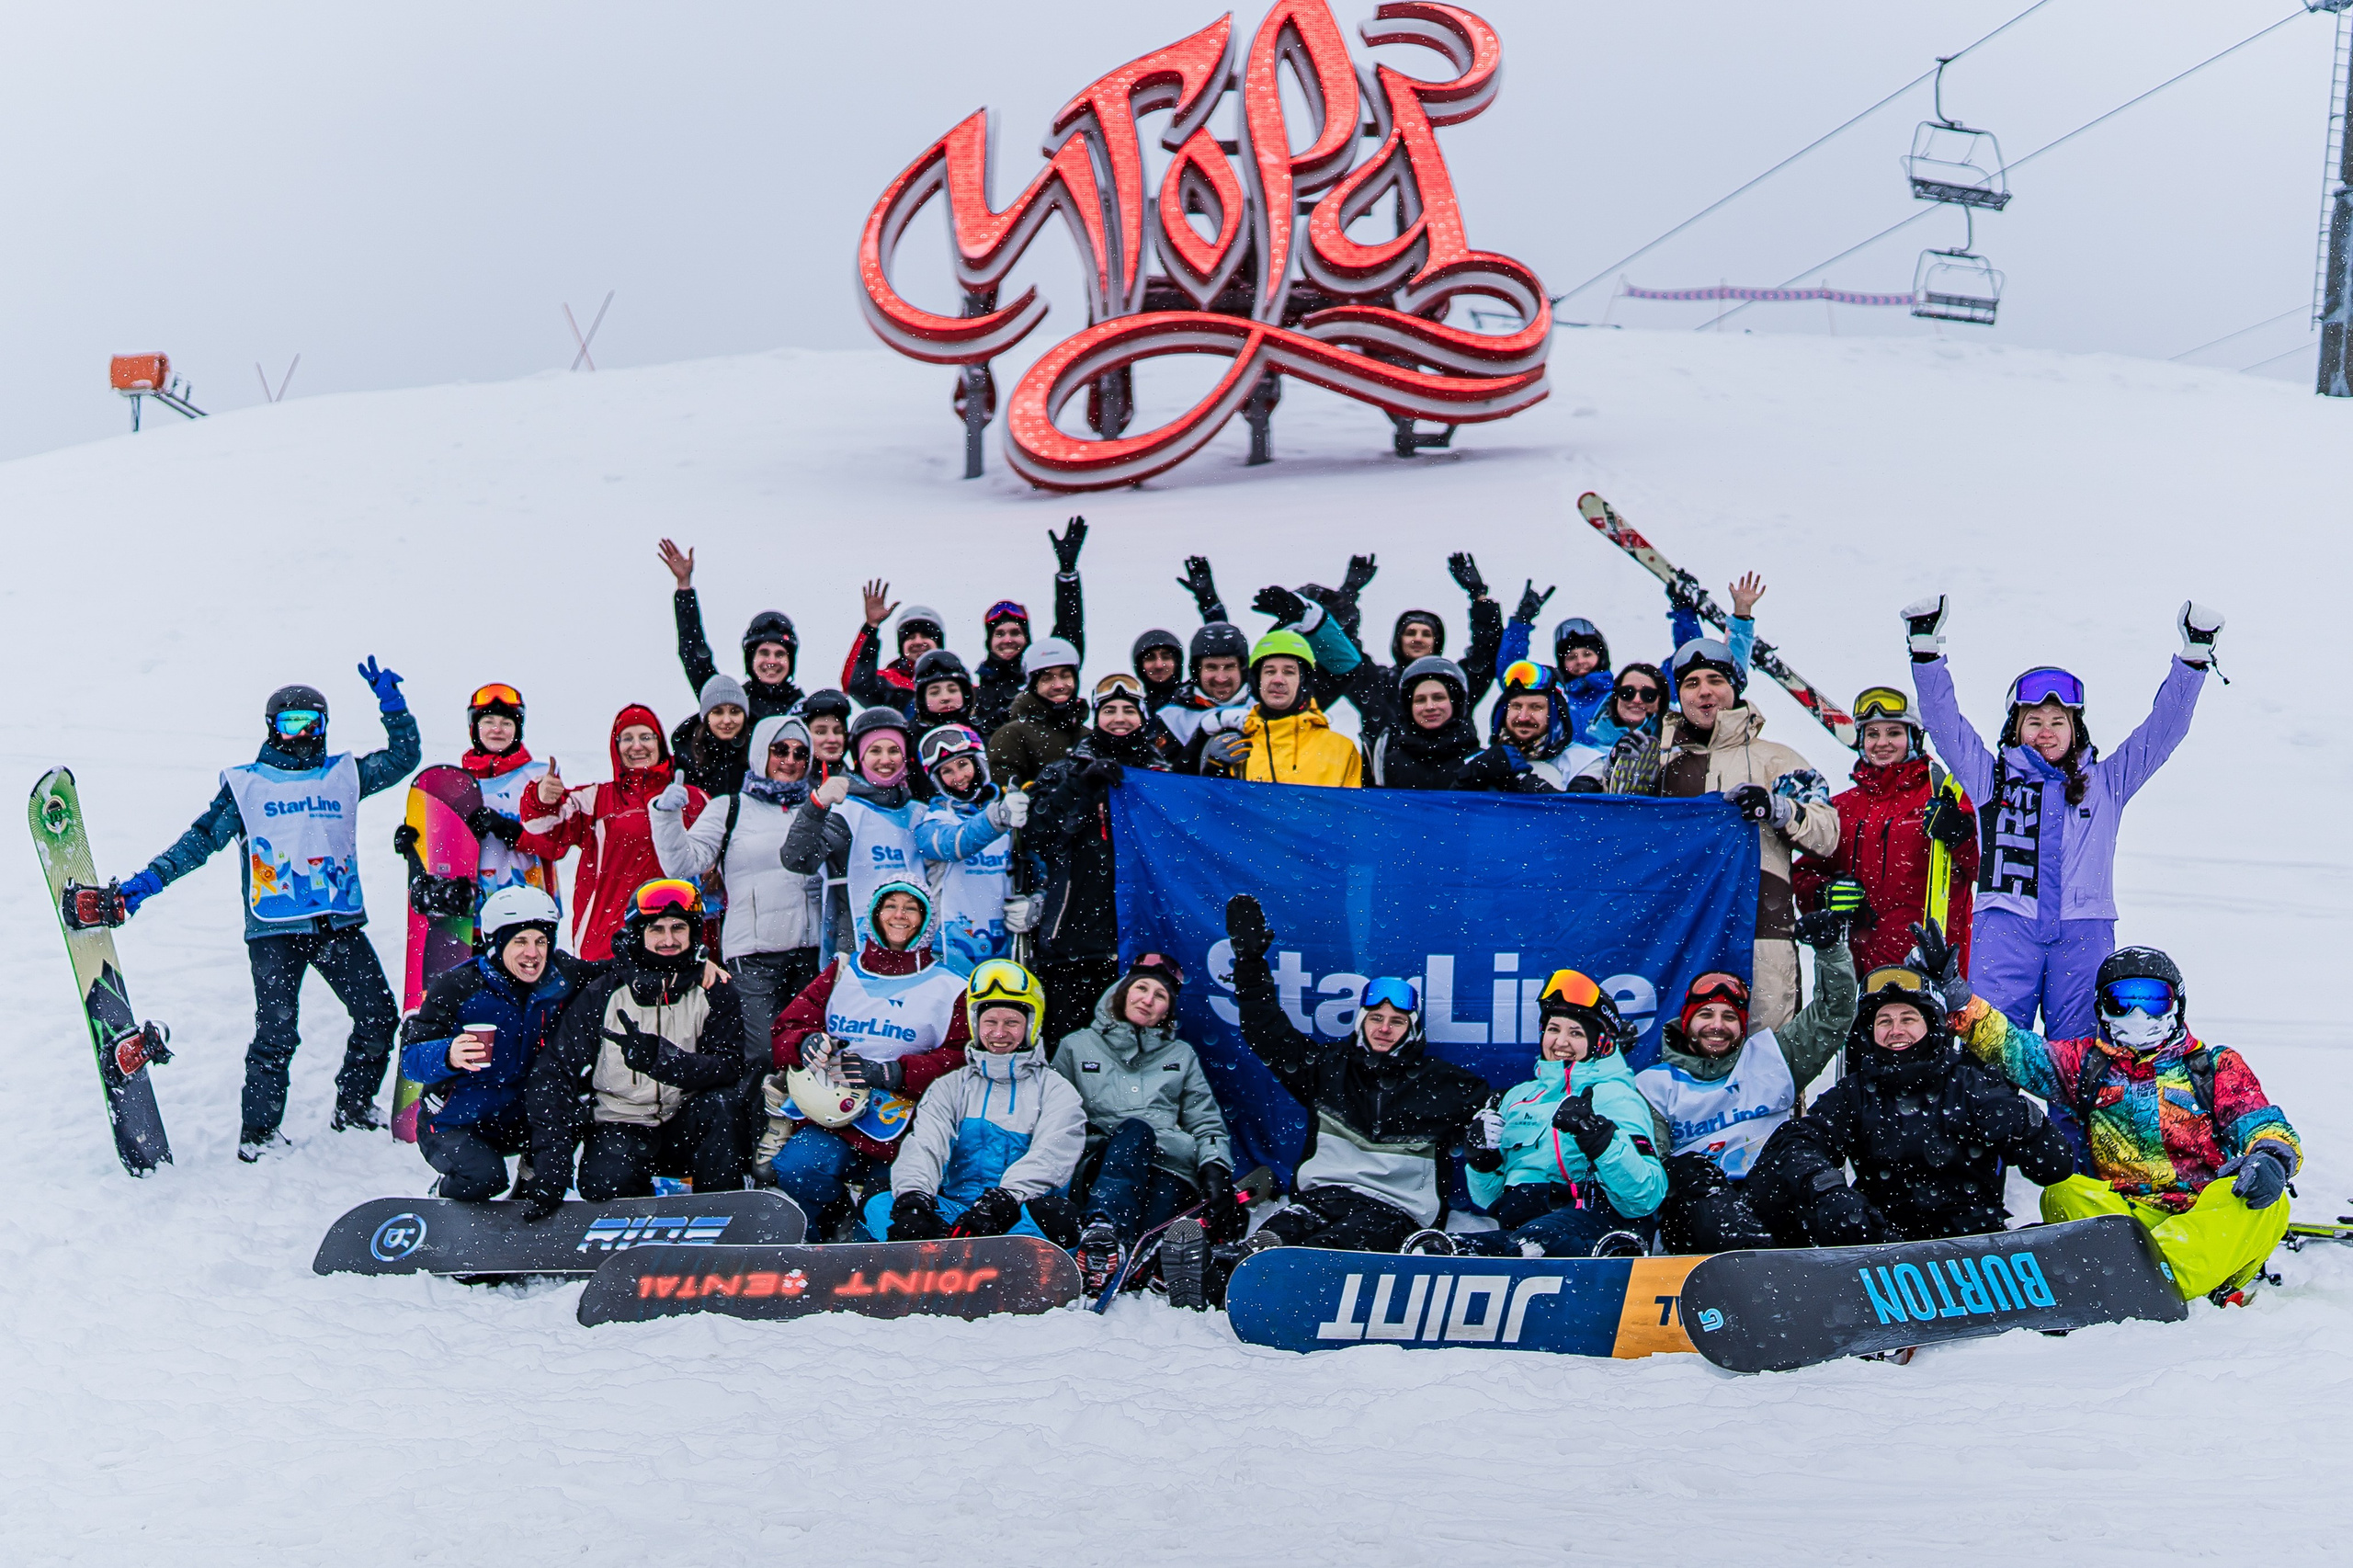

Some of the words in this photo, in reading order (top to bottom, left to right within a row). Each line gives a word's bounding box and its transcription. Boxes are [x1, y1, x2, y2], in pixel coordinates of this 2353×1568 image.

[264, 795, 341, 817] StarLine
[871, 845, 904, 862] Sta
[1206, 938, 1658, 1044] StaLie
[828, 1014, 916, 1042] StarLine
[1670, 1105, 1770, 1140] StarLine
[576, 1216, 733, 1253] RIDE
[834, 1268, 999, 1295] JOINT
[1858, 1252, 2057, 1325] BURTON
[1316, 1274, 1563, 1342] JOINT
